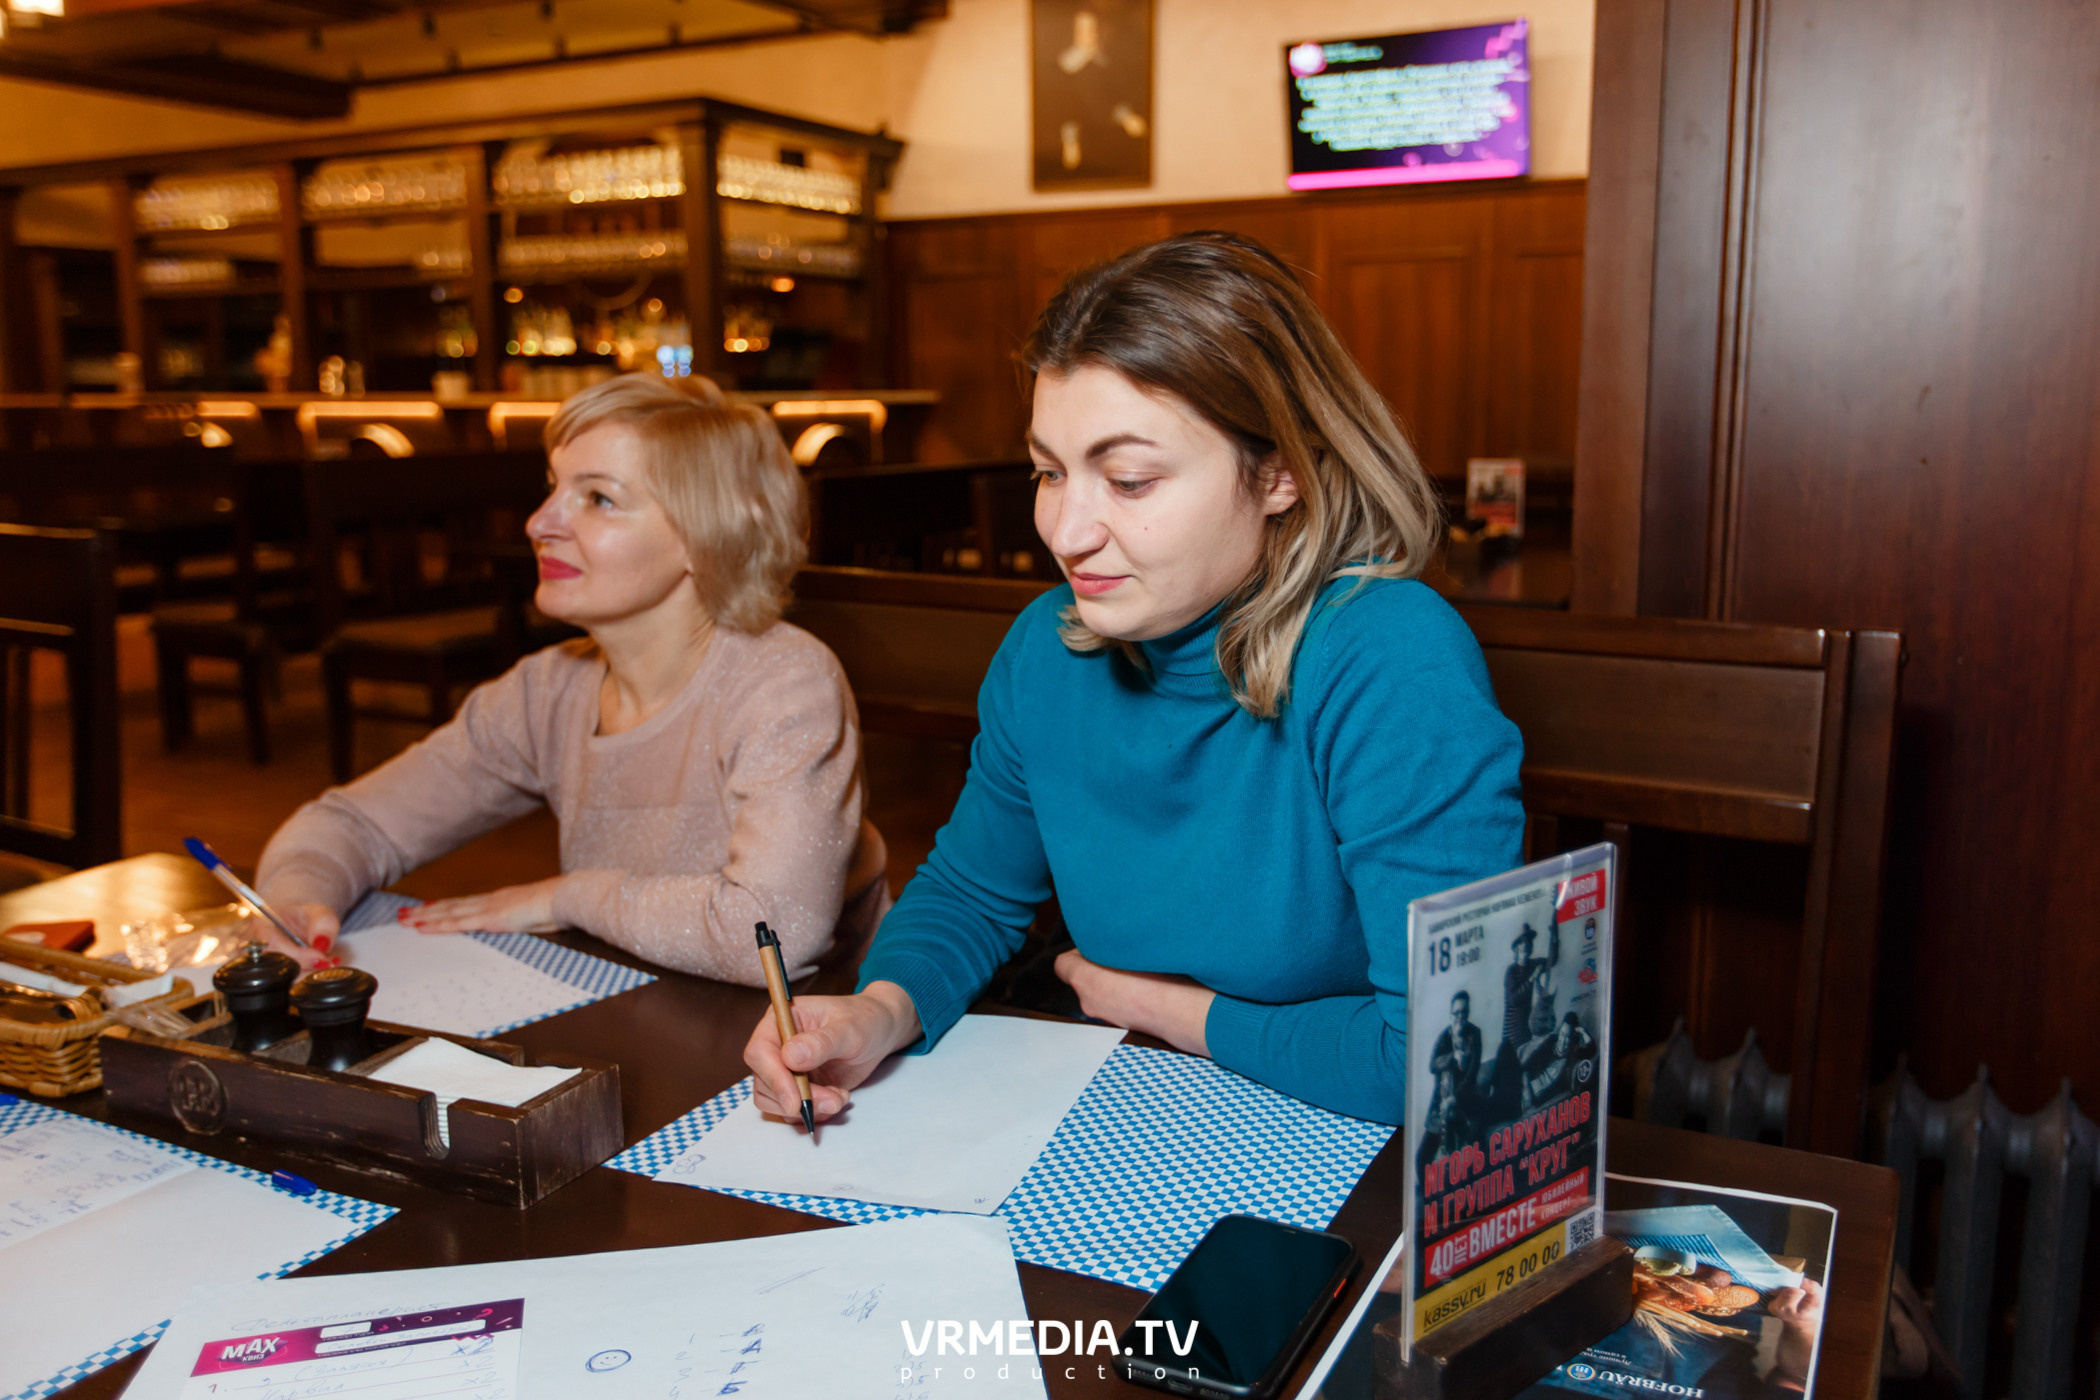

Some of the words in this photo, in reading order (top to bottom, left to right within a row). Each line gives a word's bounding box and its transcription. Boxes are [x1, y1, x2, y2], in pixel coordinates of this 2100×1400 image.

[1574, 894, 1598, 916] ЗВУК
[1455, 924, 1485, 947] МАРТА
[1429, 936, 1451, 977] 18
[1424, 1141, 1486, 1198] ИГОРЬ
[1489, 1090, 1592, 1166] САРУХАНОВ
[1424, 1200, 1438, 1238] И
[1443, 1164, 1515, 1230] ГРУППА
[1541, 1171, 1585, 1205] ЮБИЛЕЙНЫЙ
[1540, 1196, 1571, 1221] КОНЦЕРТ
[1430, 1240, 1454, 1276] 40
[1454, 1234, 1468, 1265] ЛЕТ
[1469, 1196, 1538, 1259] ВМЕСТЕ
[1423, 1280, 1487, 1329] kassy.ru
[1496, 1265, 1515, 1291] 78
[1520, 1252, 1538, 1278] 00
[1542, 1240, 1560, 1266] 00
[221, 1337, 281, 1360] MAX
[242, 1353, 265, 1363] КВИЗ
[1598, 1370, 1705, 1398] HOFBRÄU
